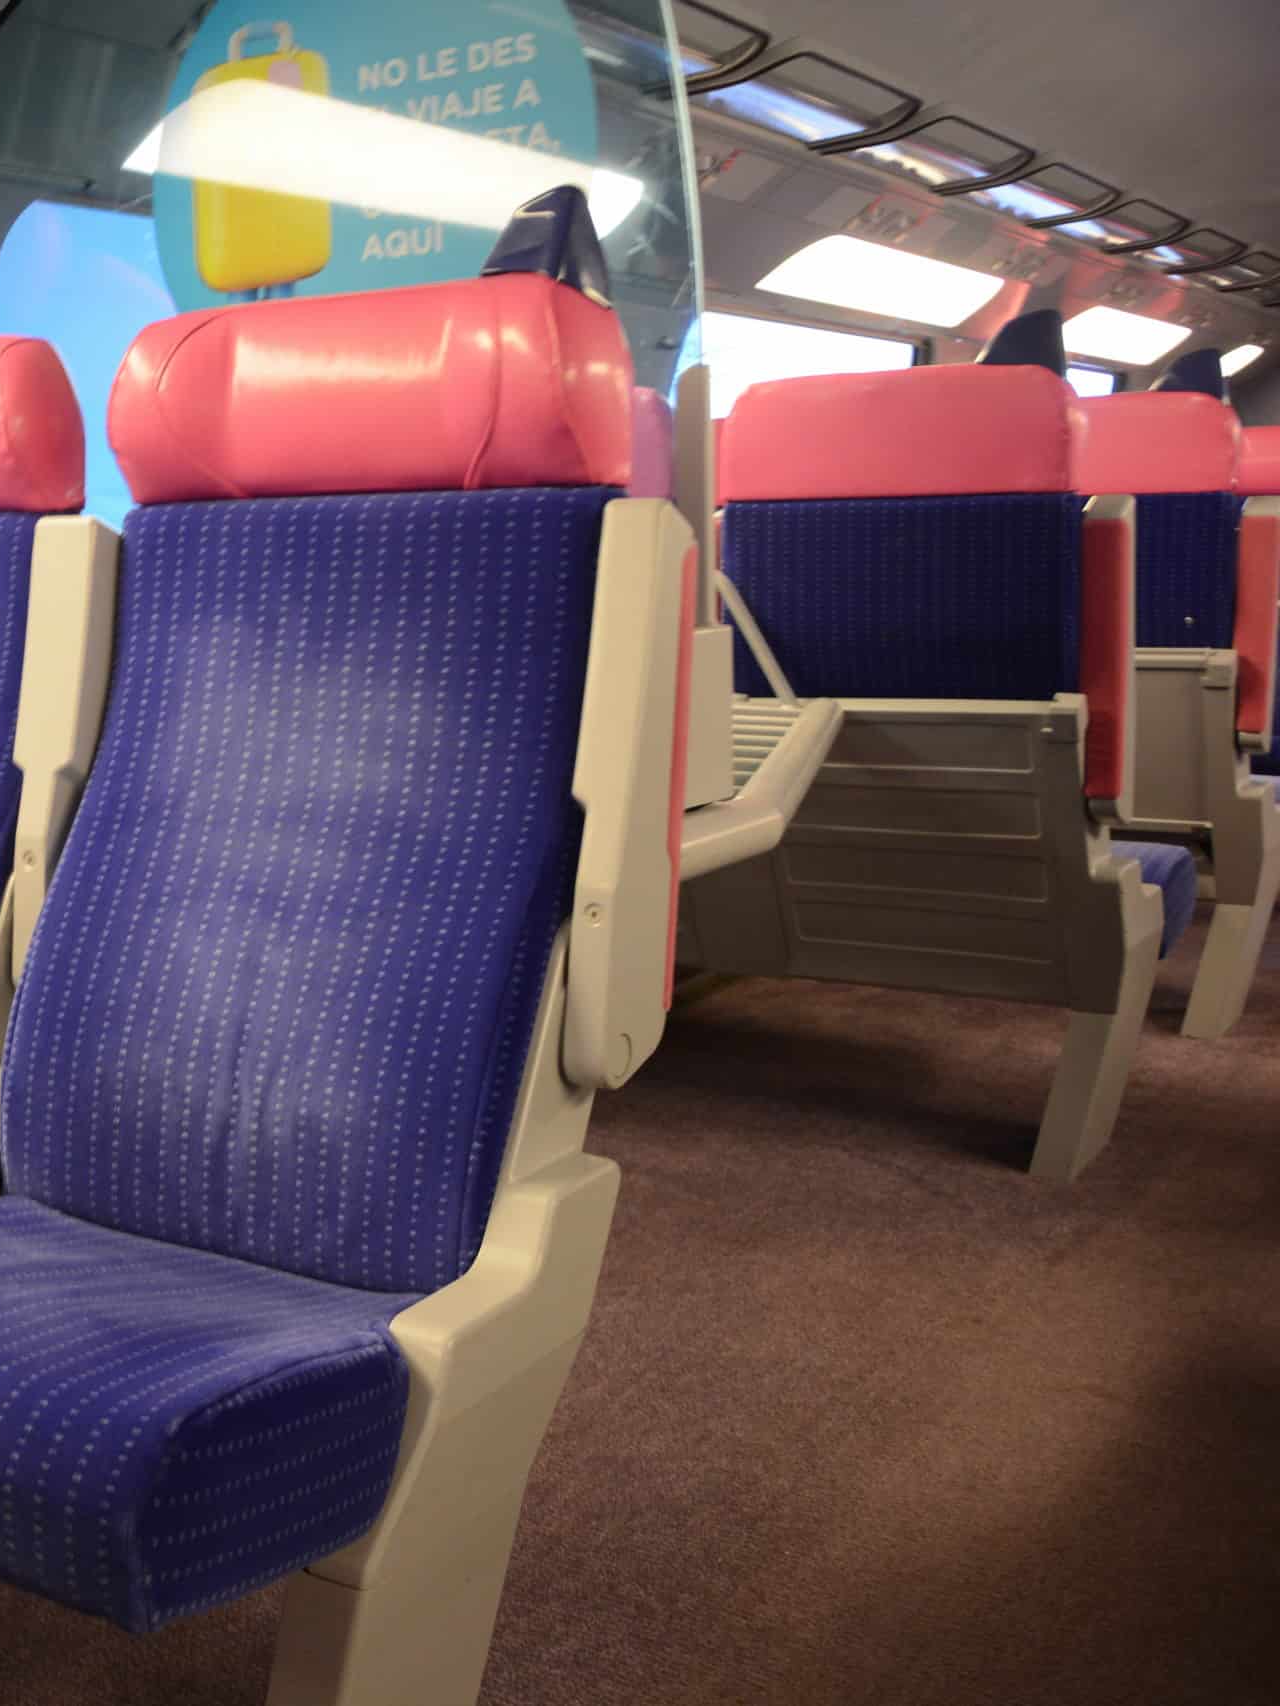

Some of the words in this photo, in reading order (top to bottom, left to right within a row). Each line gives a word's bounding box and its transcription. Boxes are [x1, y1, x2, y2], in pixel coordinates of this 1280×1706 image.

[358, 57, 408, 93] NO
[416, 47, 458, 82] LE
[466, 32, 538, 73] DES
[406, 83, 505, 123] VIAJE
[512, 78, 541, 109] A
